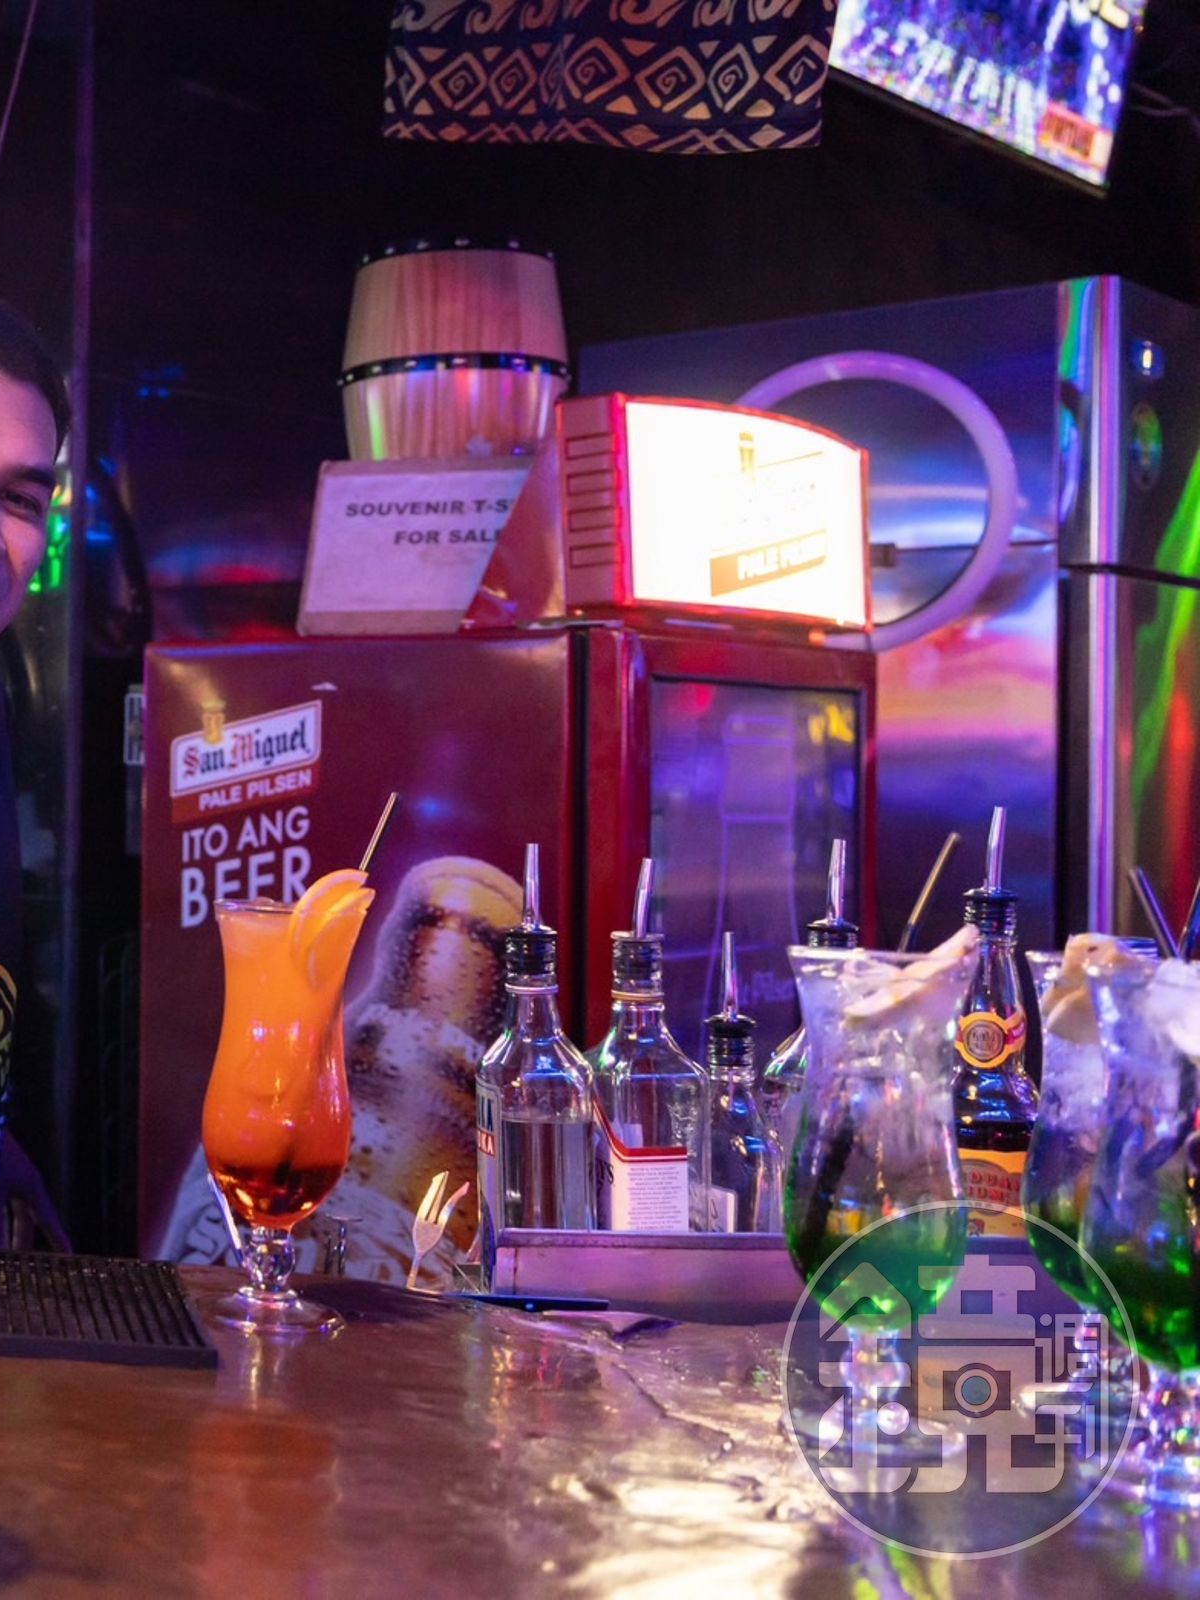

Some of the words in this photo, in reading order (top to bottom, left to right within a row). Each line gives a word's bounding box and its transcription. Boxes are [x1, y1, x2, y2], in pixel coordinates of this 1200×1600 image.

[346, 500, 465, 517] SOUVENIR
[394, 530, 440, 545] FOR
[183, 745, 225, 777] San
[228, 717, 309, 767] Miguel
[199, 785, 242, 812] PALE
[247, 769, 313, 800] PILSEN
[182, 823, 229, 863] ITO
[237, 806, 311, 851] ANG
[181, 846, 311, 928] BEER
